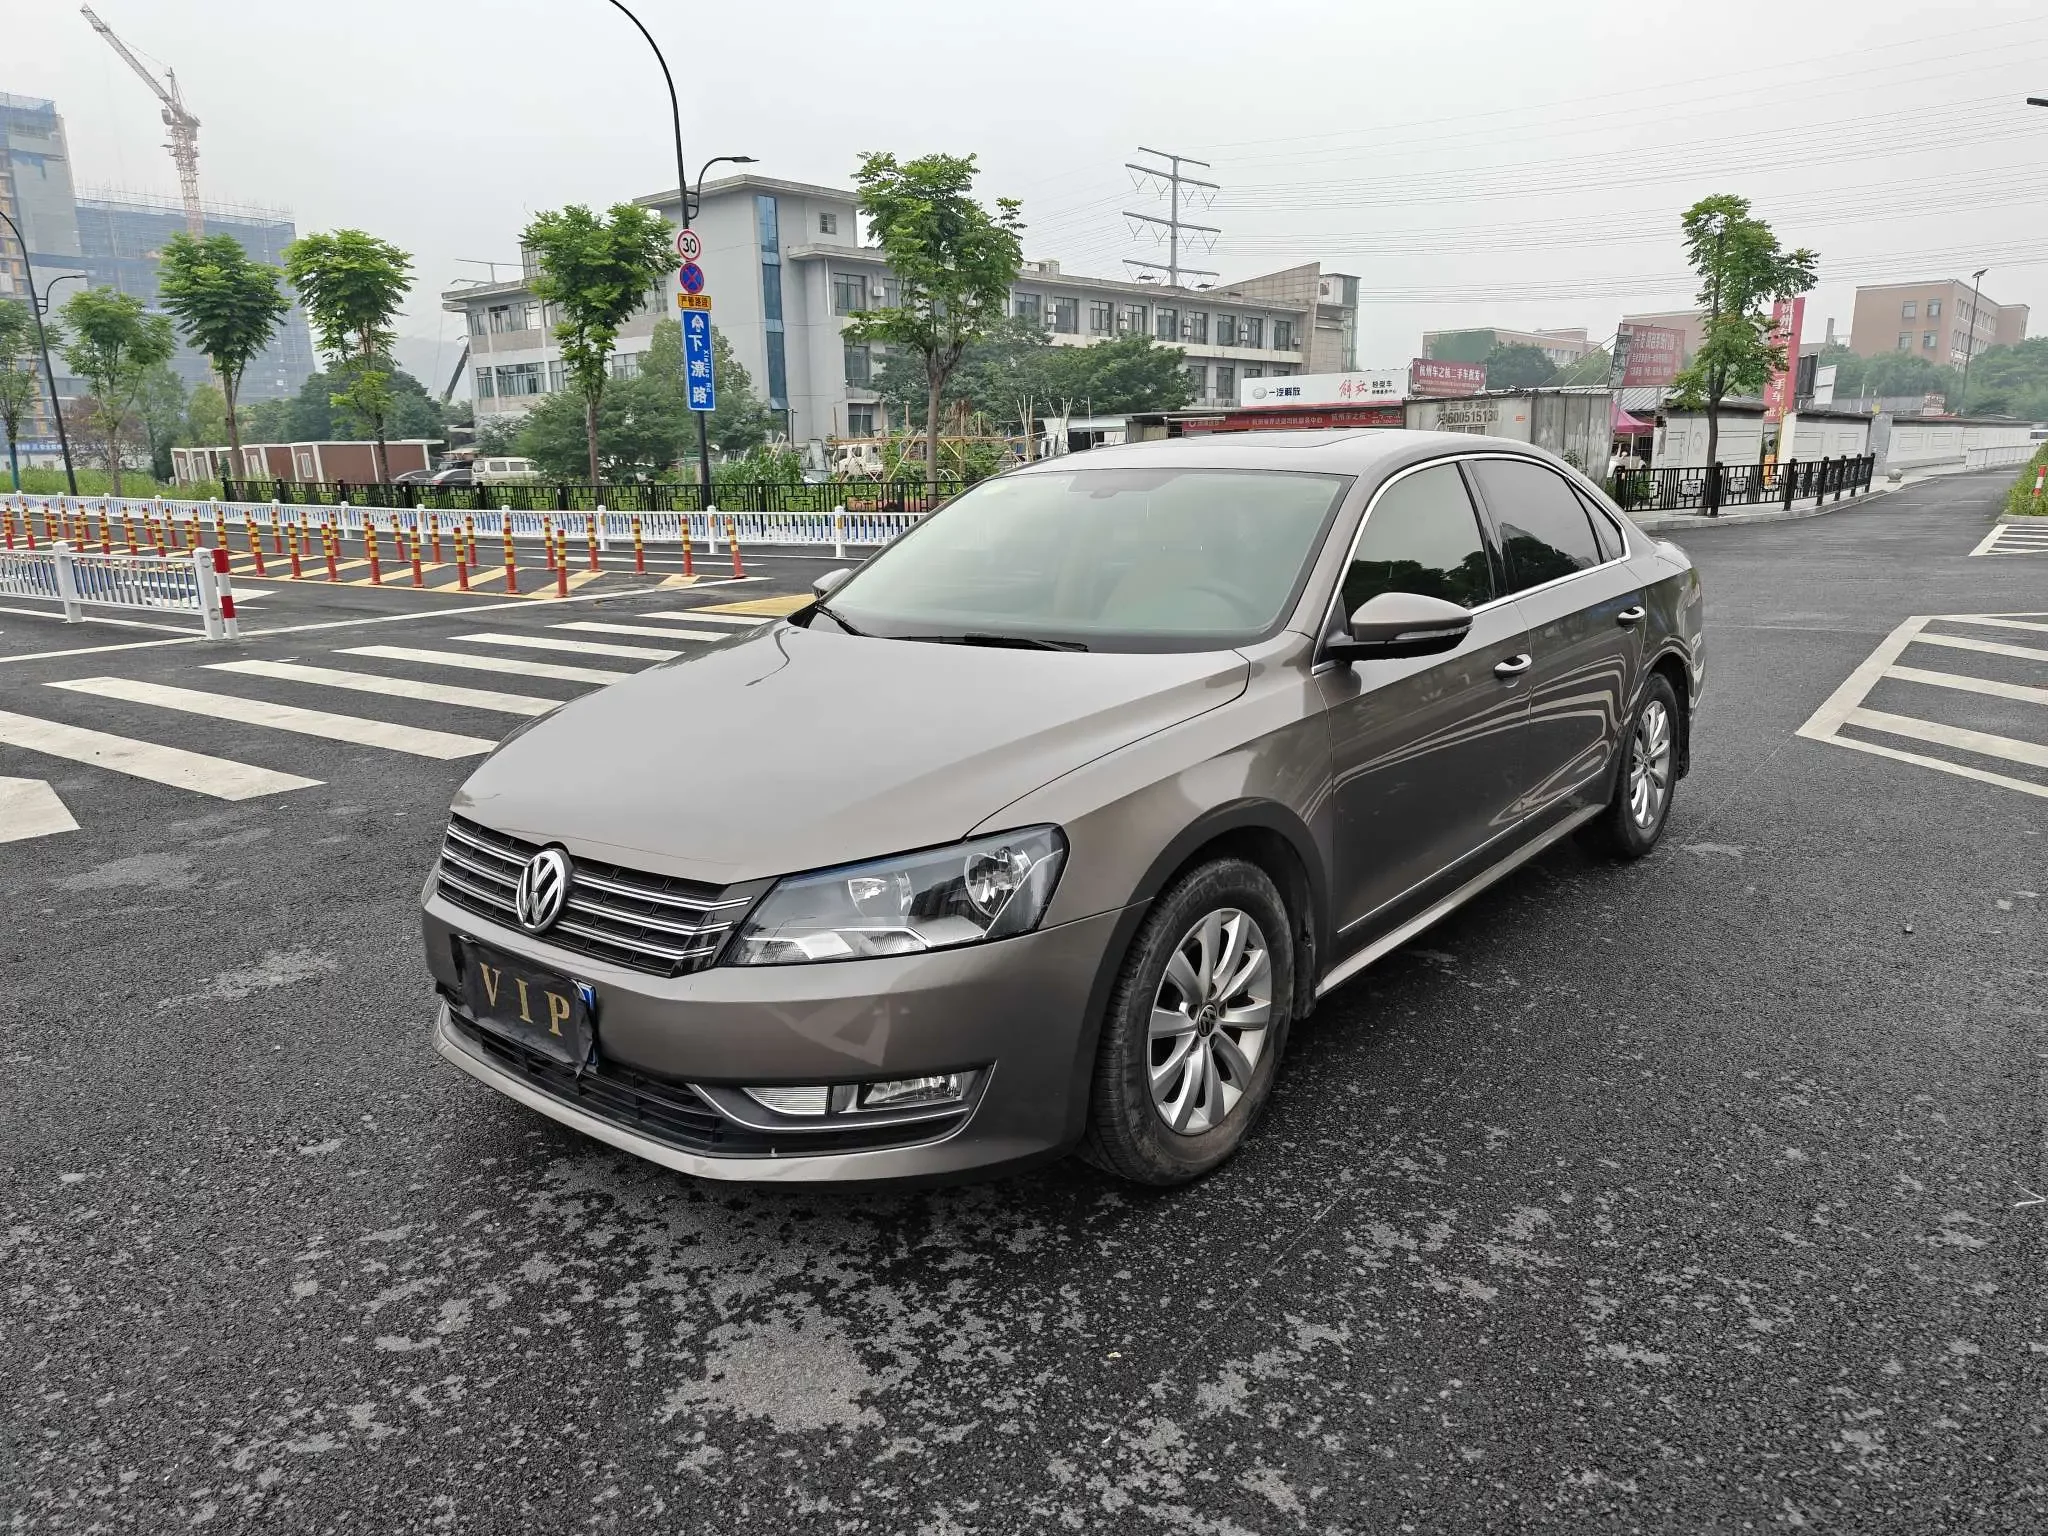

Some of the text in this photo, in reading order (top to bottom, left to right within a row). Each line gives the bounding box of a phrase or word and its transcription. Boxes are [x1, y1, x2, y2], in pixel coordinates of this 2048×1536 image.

[682, 238, 697, 254] 30
[680, 295, 708, 307] 严管路段
[1268, 386, 1301, 397] 一汽解放
[479, 961, 571, 1038] VIP
